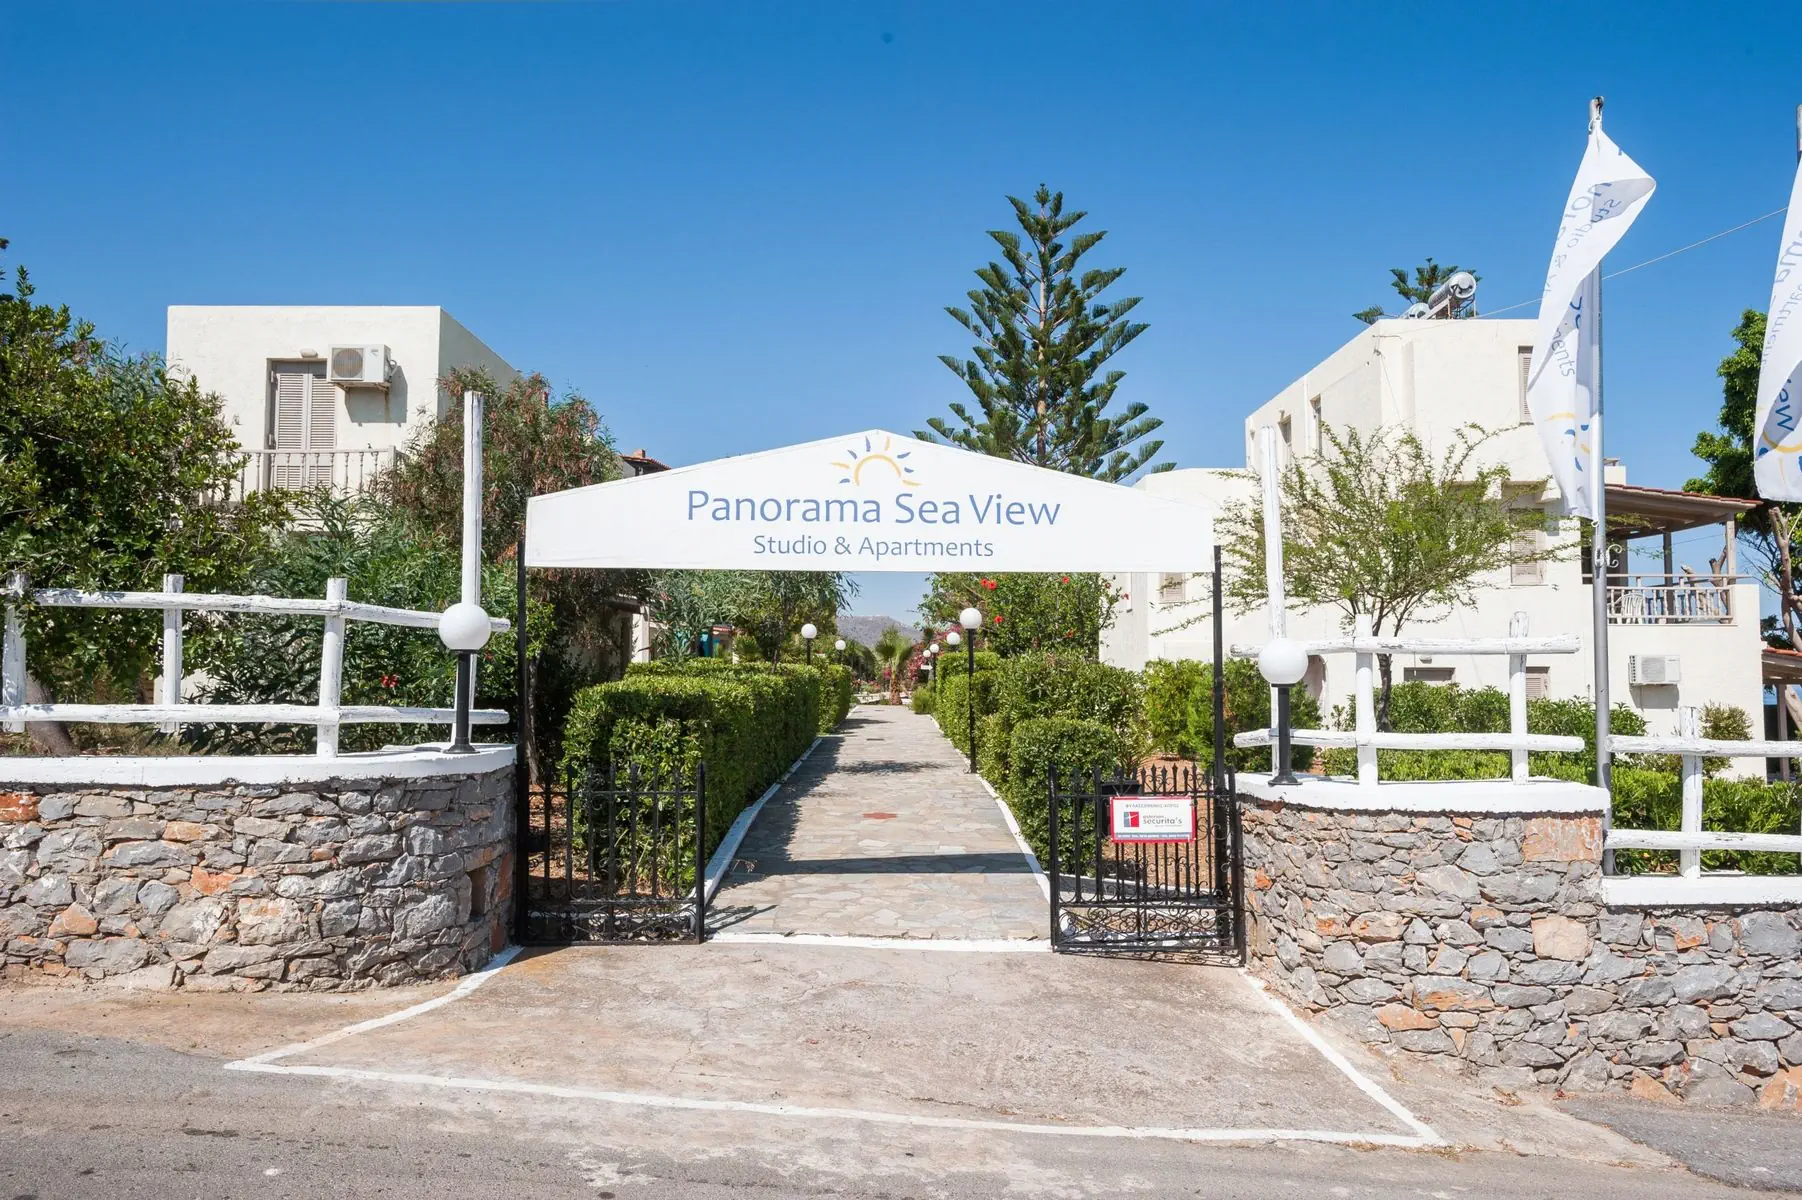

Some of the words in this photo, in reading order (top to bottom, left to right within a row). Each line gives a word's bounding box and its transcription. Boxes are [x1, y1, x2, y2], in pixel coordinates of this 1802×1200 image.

[688, 490, 881, 522] Panorama
[895, 493, 960, 524] Sea
[969, 495, 1060, 526] View
[753, 534, 827, 555] Studio
[834, 536, 852, 555] &
[858, 536, 994, 561] Apartments
